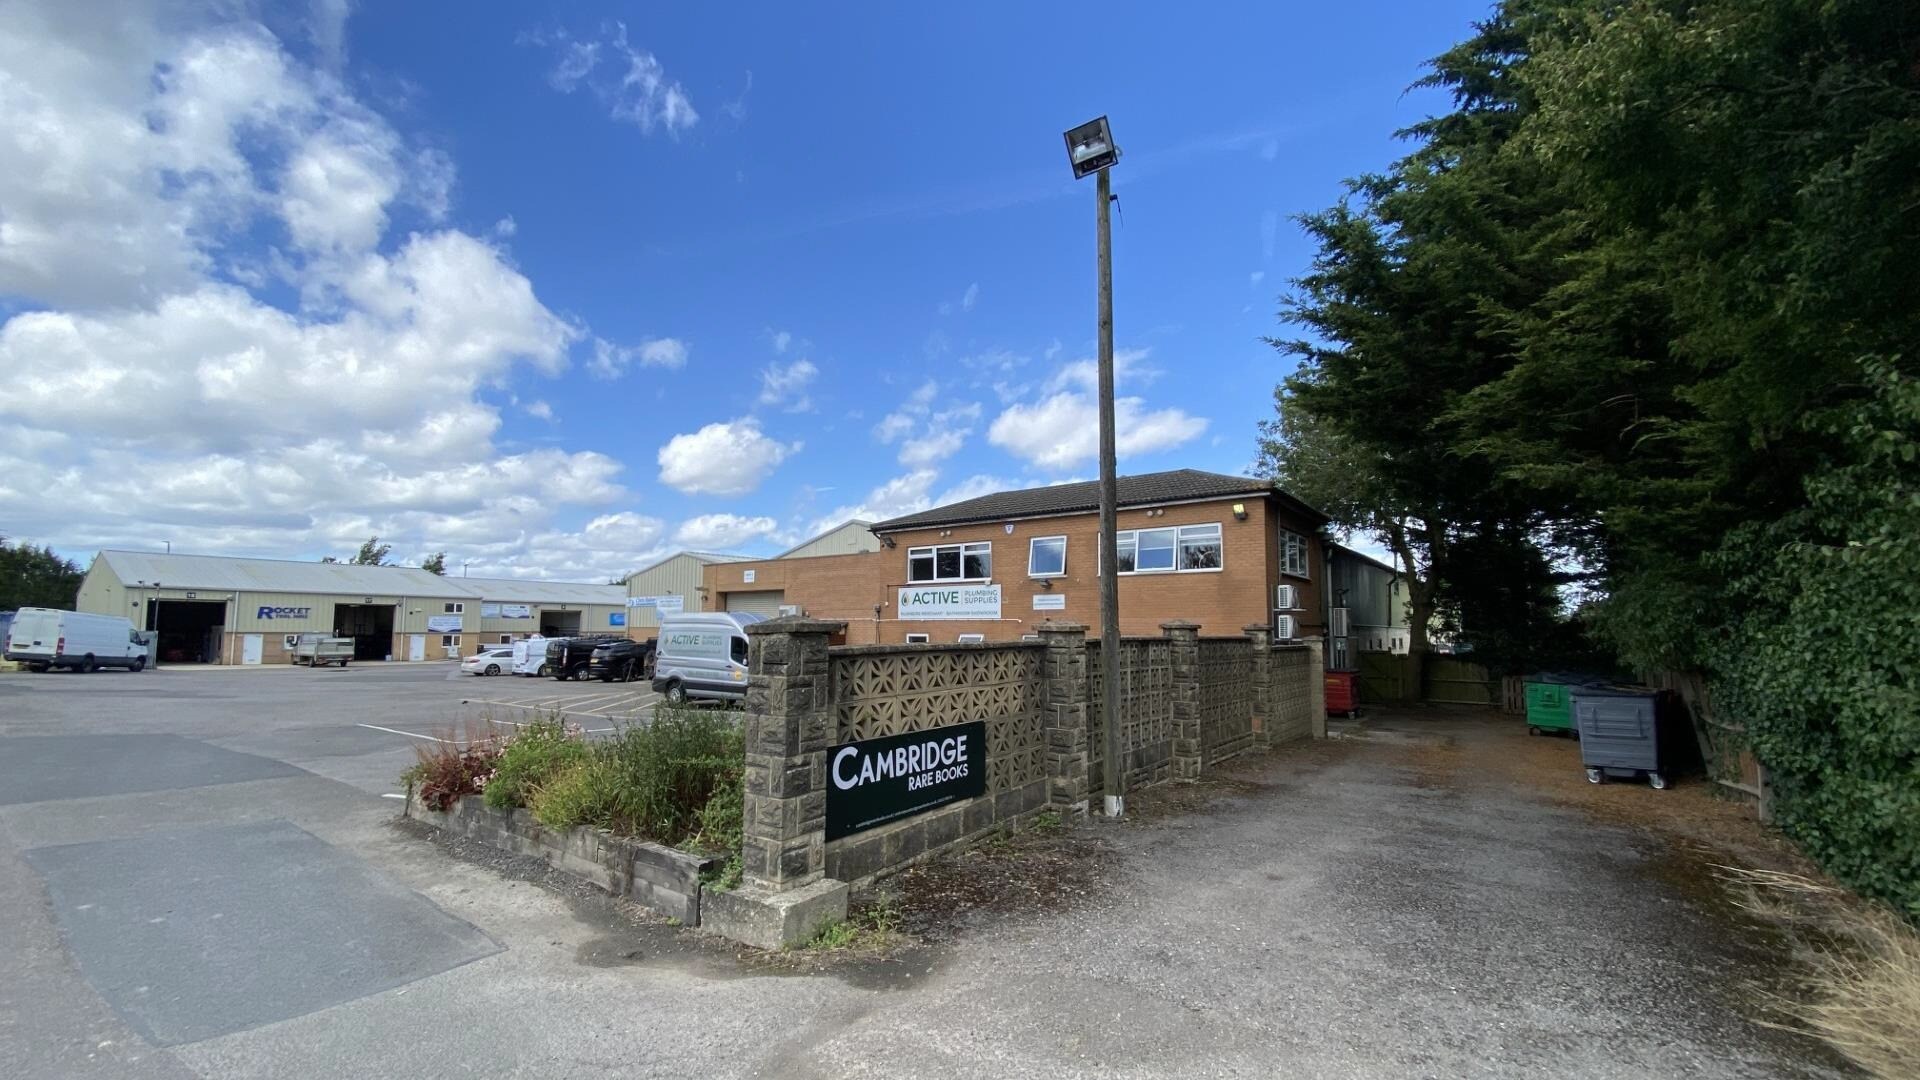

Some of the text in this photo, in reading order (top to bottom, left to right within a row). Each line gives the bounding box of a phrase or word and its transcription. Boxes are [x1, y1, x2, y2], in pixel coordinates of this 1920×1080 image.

[912, 591, 959, 605] ACTIVE
[964, 596, 998, 604] SUPPLIES
[257, 606, 311, 619] ROCKET
[671, 634, 700, 645] ACTIVE
[832, 735, 967, 790] CAMBRIDGE
[908, 764, 968, 791] RARE BOOKS
